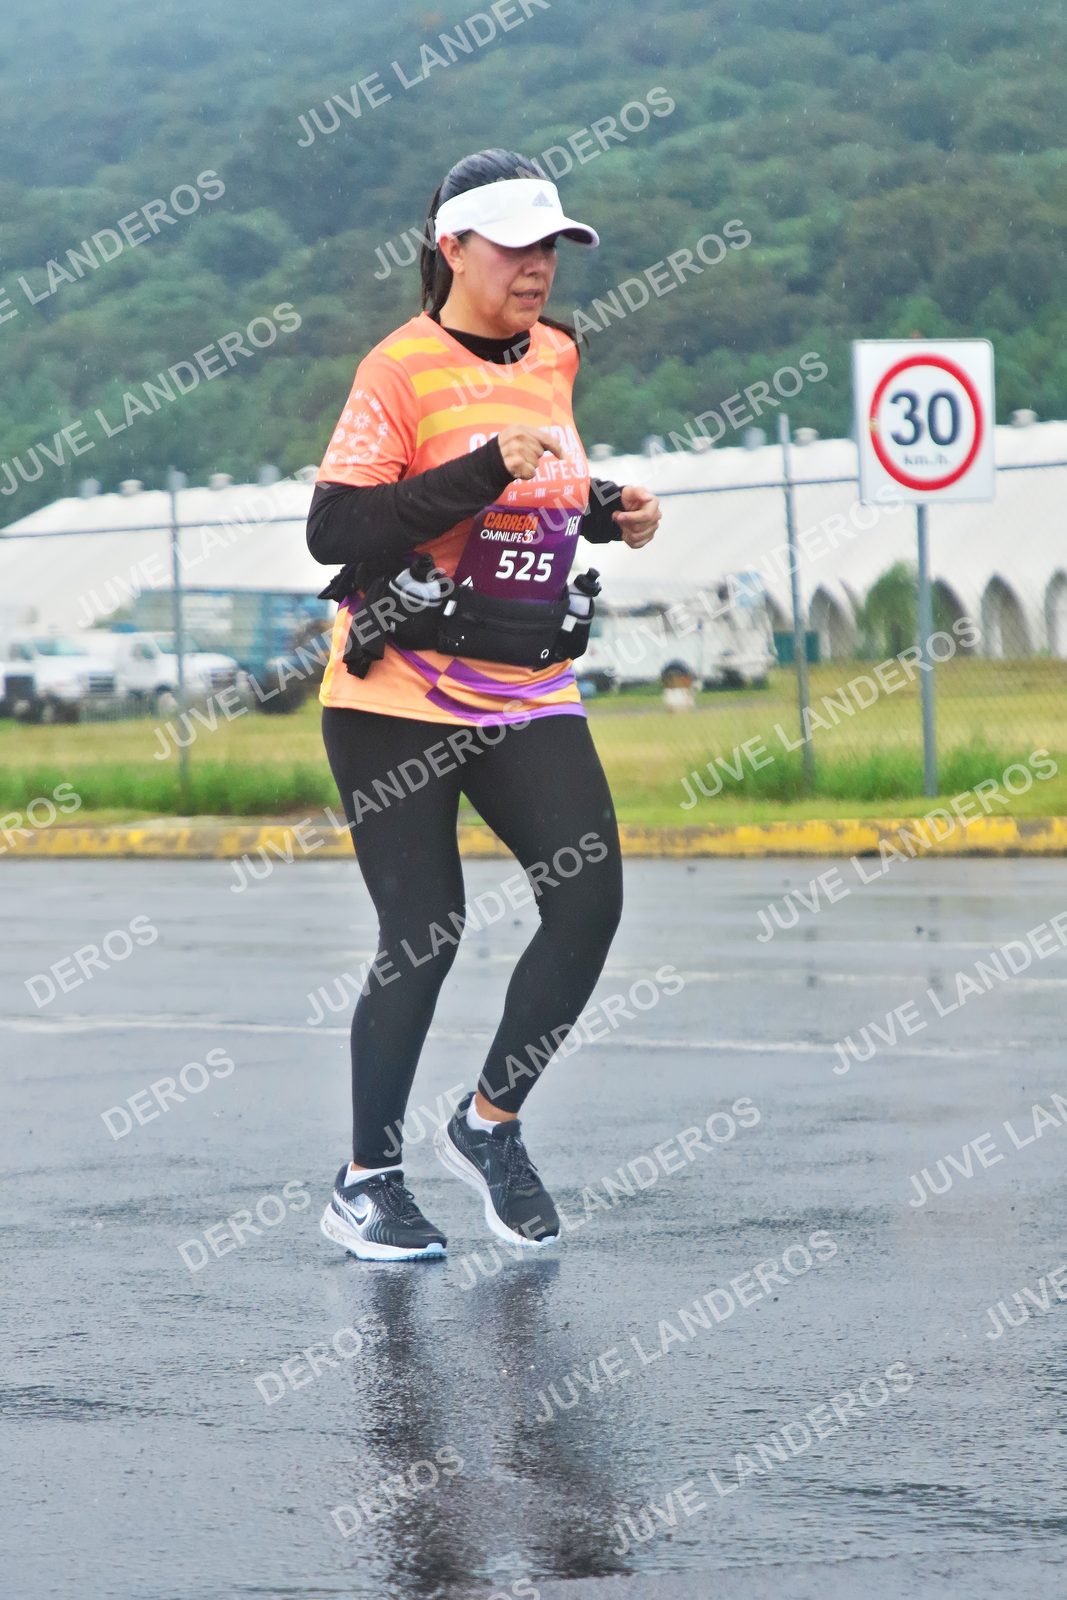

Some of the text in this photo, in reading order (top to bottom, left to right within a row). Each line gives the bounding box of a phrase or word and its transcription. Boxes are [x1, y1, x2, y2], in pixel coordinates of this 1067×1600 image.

[890, 389, 961, 446] 30
[483, 512, 539, 530] CARRERA
[494, 549, 555, 583] 525
